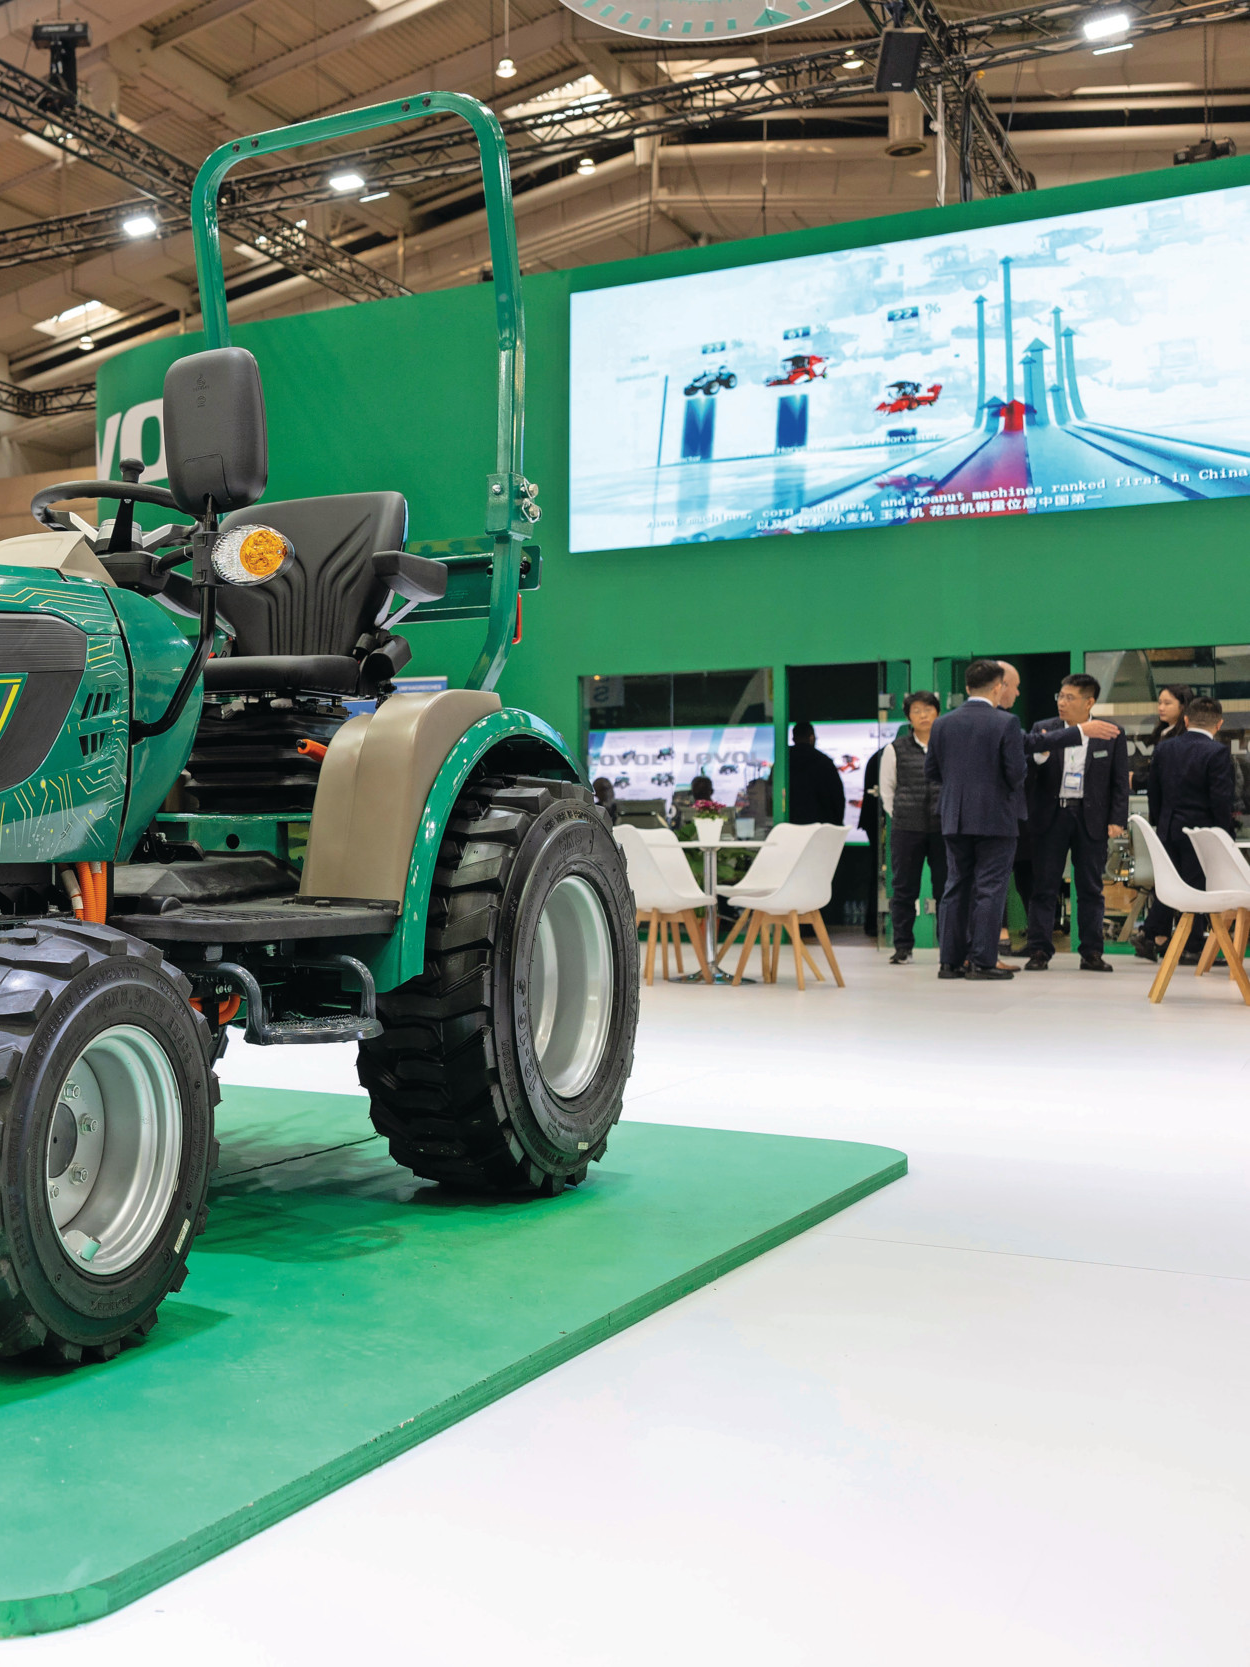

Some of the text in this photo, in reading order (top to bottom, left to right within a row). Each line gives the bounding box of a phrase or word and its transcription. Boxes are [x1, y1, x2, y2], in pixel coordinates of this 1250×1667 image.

[762, 507, 794, 518] corn
[881, 495, 906, 507] and
[913, 490, 964, 507] peanut
[972, 485, 1042, 501] machines
[1051, 479, 1106, 493] ranked
[1115, 472, 1161, 487] first
[1172, 471, 1190, 483] in
[1198, 466, 1249, 481] China
